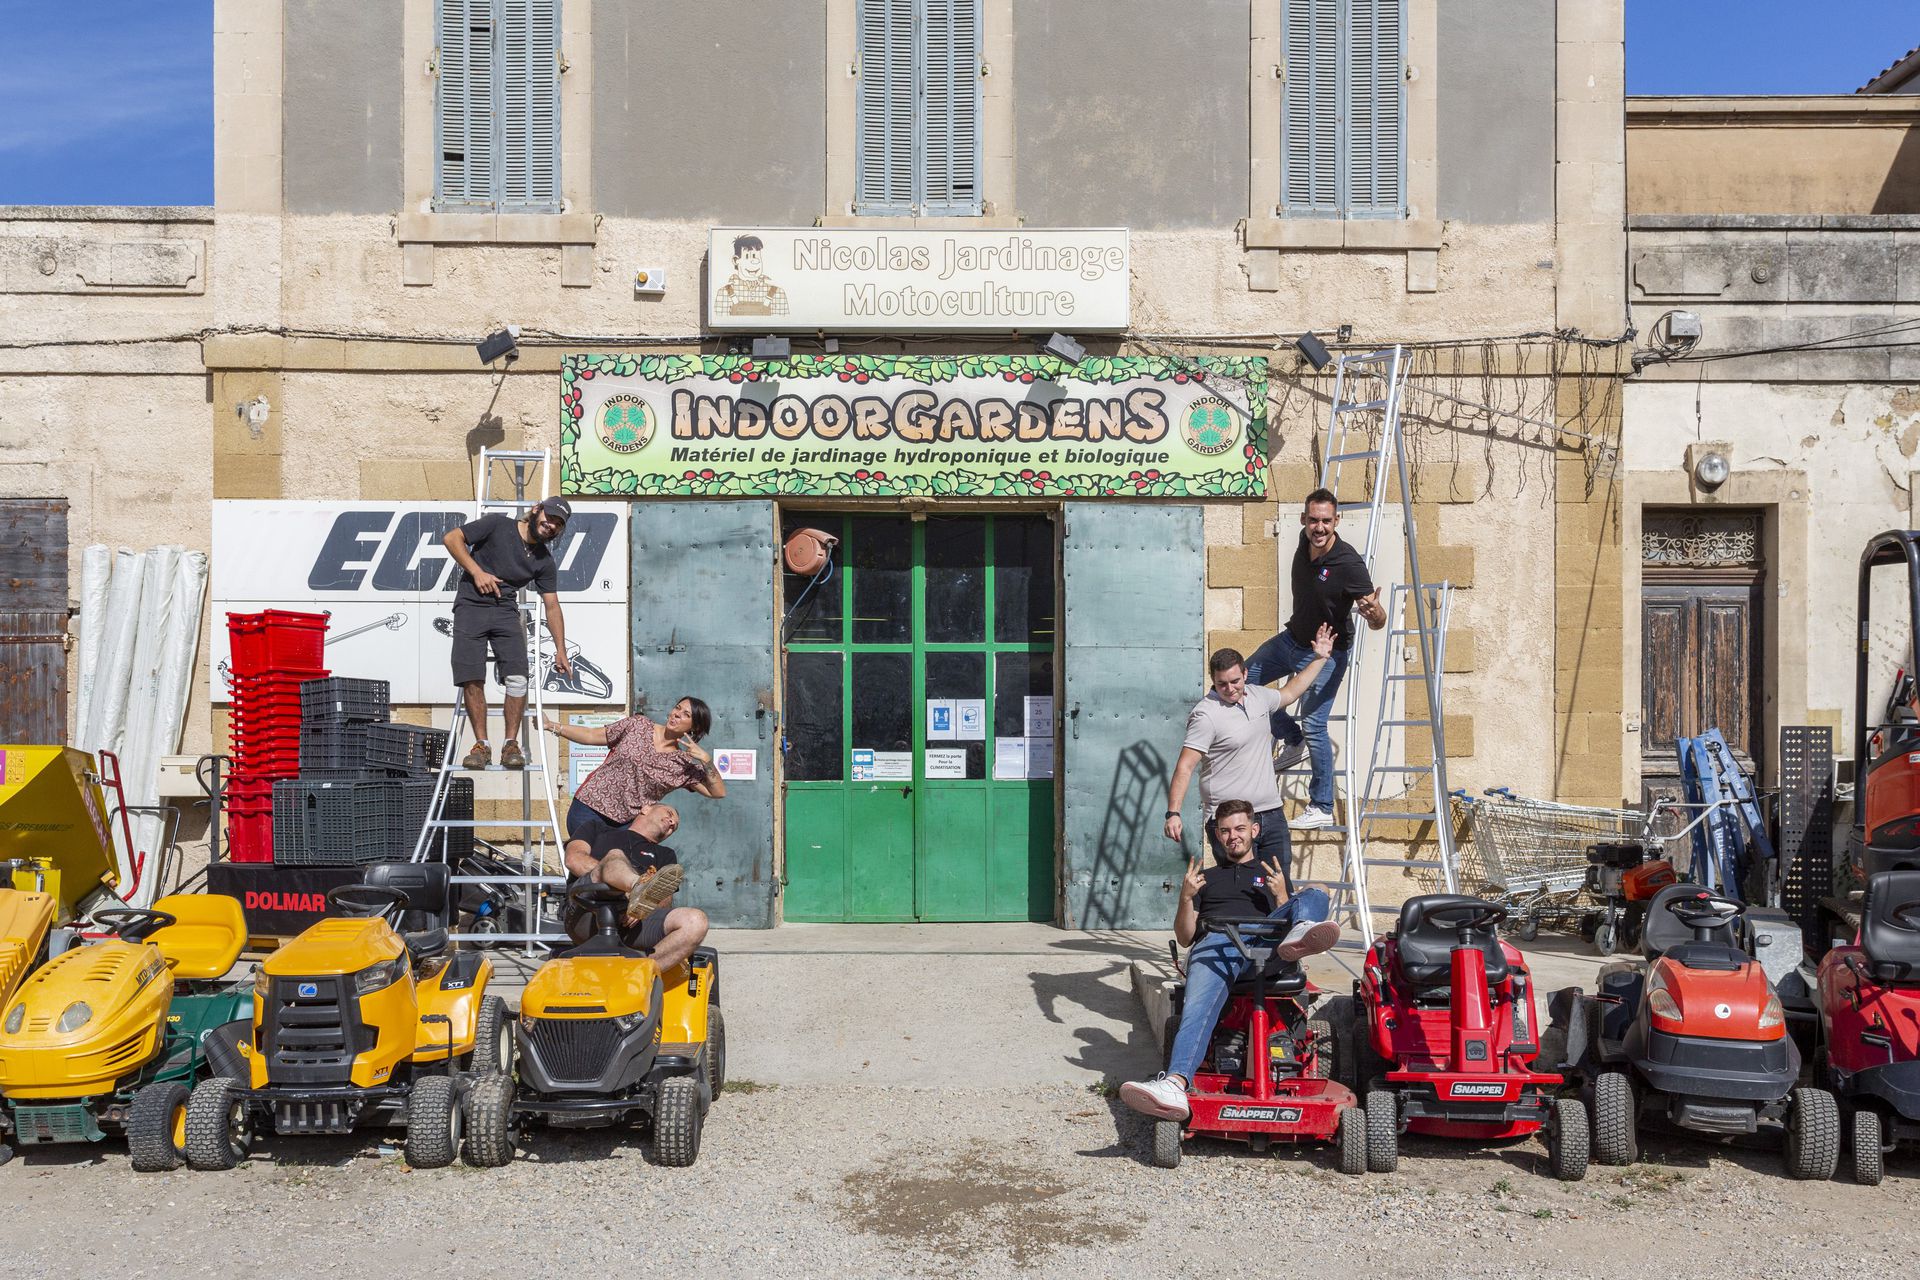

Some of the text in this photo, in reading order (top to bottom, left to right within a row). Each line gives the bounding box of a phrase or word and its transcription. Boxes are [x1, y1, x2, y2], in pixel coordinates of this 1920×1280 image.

[794, 237, 1125, 281] Nicolas Jardinage
[843, 281, 1075, 316] Motoculture
[604, 394, 646, 409] INDOOR
[1189, 396, 1231, 411] INDOOR
[602, 436, 648, 452] GARDENS
[1187, 437, 1233, 454] GARDENS
[671, 447, 1169, 467] Matériel de jardinage hydroponique et biologique
[308, 511, 618, 591] ECO
[245, 891, 326, 912] DOLMAR
[374, 1065, 389, 1076] XT1
[1453, 1083, 1503, 1095] SNAPPER
[1222, 1106, 1275, 1120] SNAPPER
